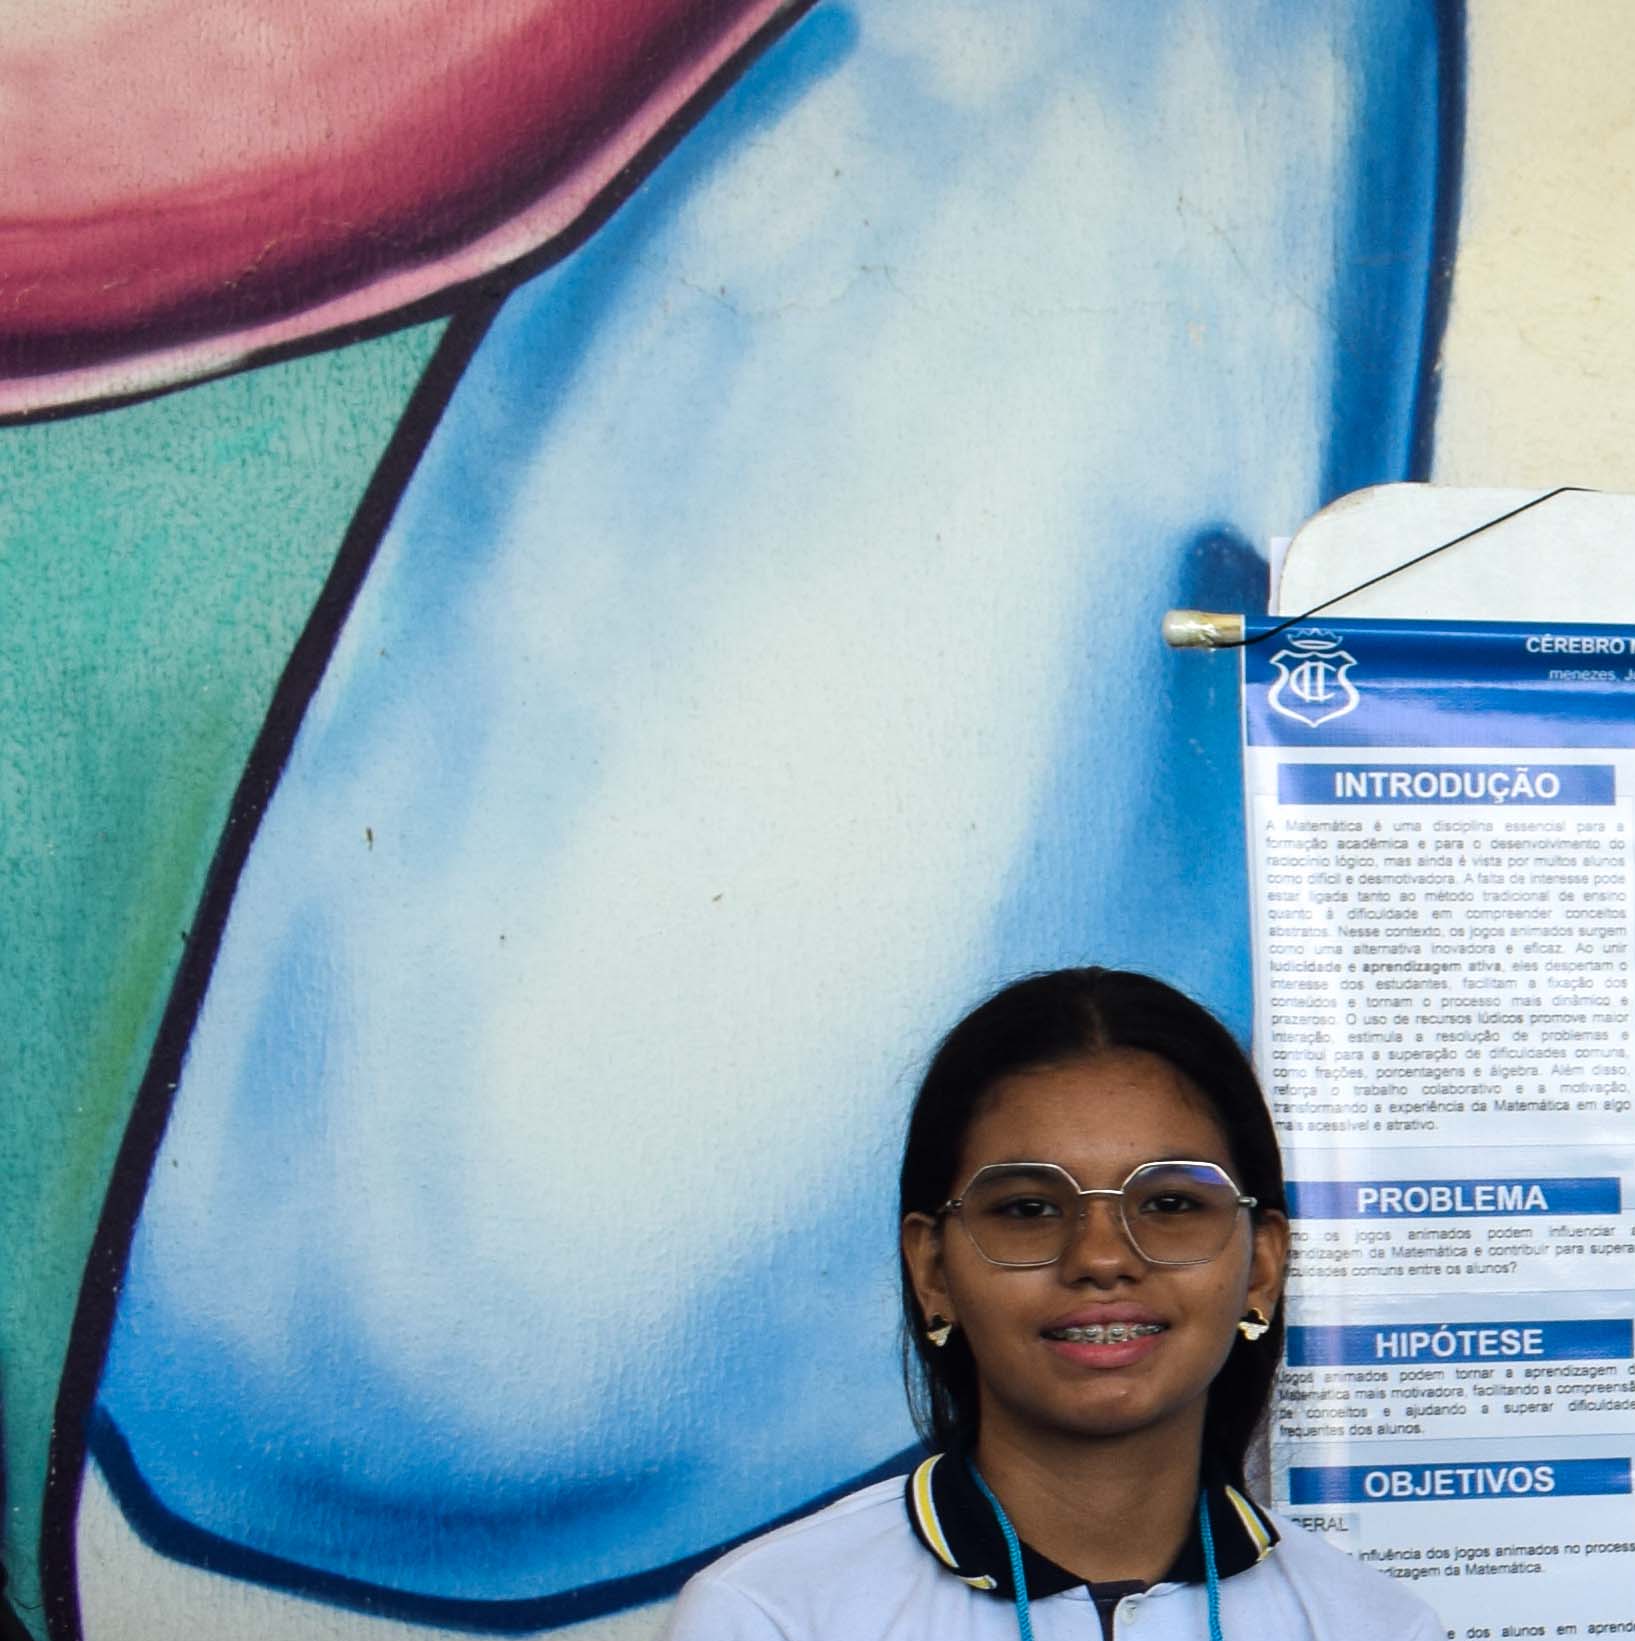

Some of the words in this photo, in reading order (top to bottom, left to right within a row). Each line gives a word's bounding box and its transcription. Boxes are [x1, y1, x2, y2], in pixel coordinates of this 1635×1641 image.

[1526, 634, 1624, 654] CÉREBRO
[1335, 768, 1560, 803] INTRODUÇÃO
[1358, 1186, 1548, 1213] PROBLEMA
[1376, 1324, 1544, 1358] HIPÓTESE
[1364, 1465, 1555, 1498] OBJETIVOS
[1358, 1545, 1421, 1560] influência
[1425, 1544, 1450, 1558] dos
[1454, 1543, 1490, 1561] jogos
[1495, 1541, 1559, 1556] animados
[1563, 1545, 1580, 1554] no
